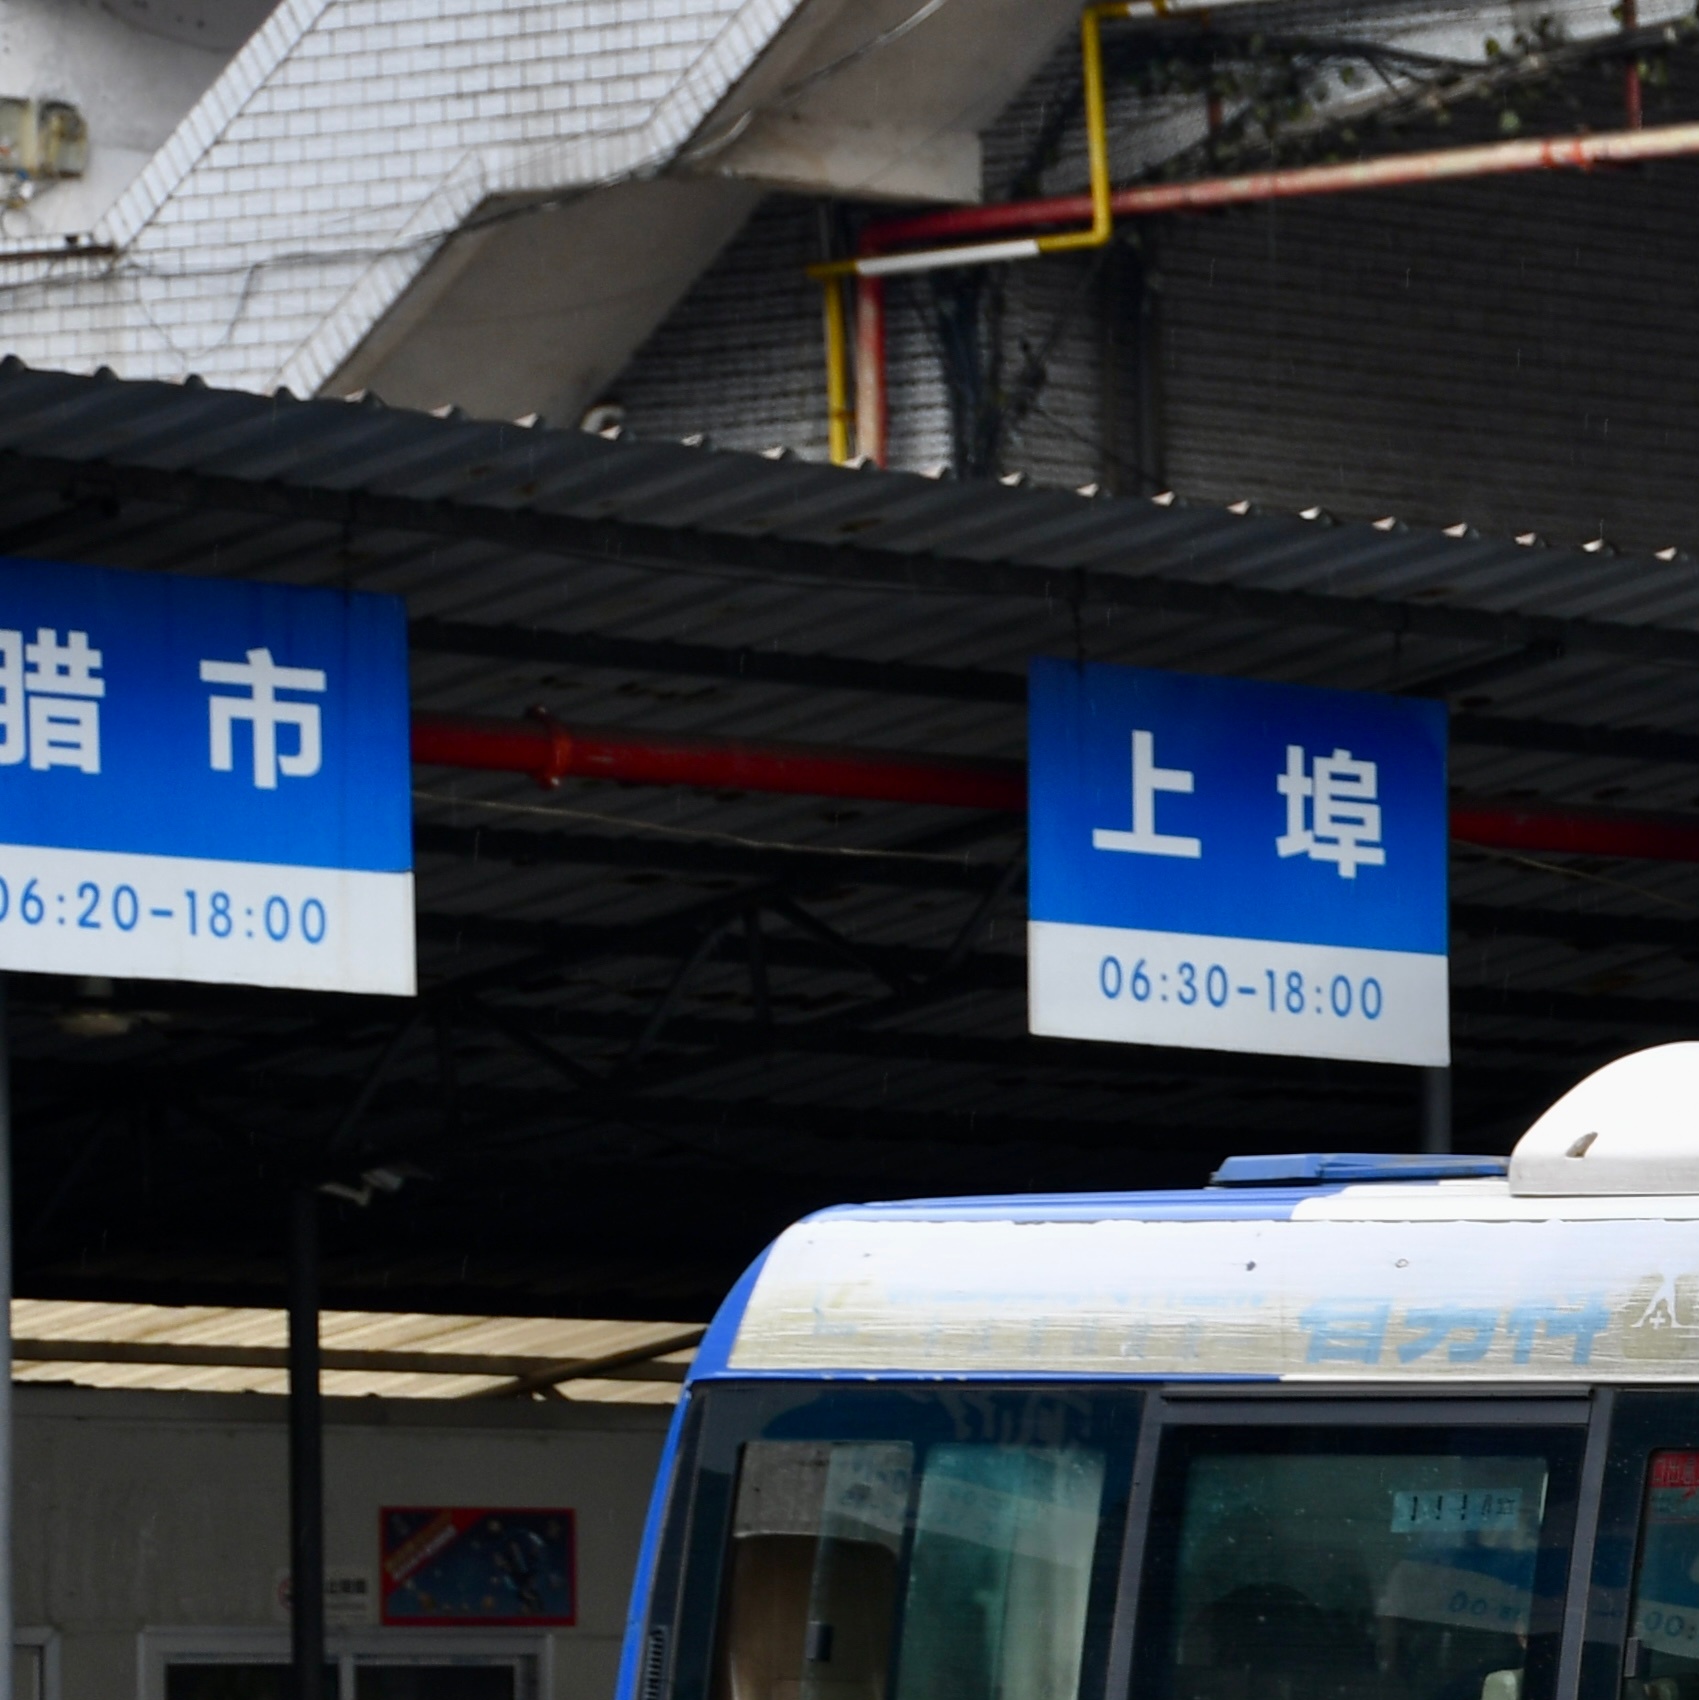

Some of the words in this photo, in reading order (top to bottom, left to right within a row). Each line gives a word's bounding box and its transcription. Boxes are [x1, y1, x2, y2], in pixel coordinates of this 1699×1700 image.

[0, 627, 327, 790] 腊市
[1092, 729, 1386, 880] 上埠
[1100, 955, 1384, 1020] 06:30-18:00
